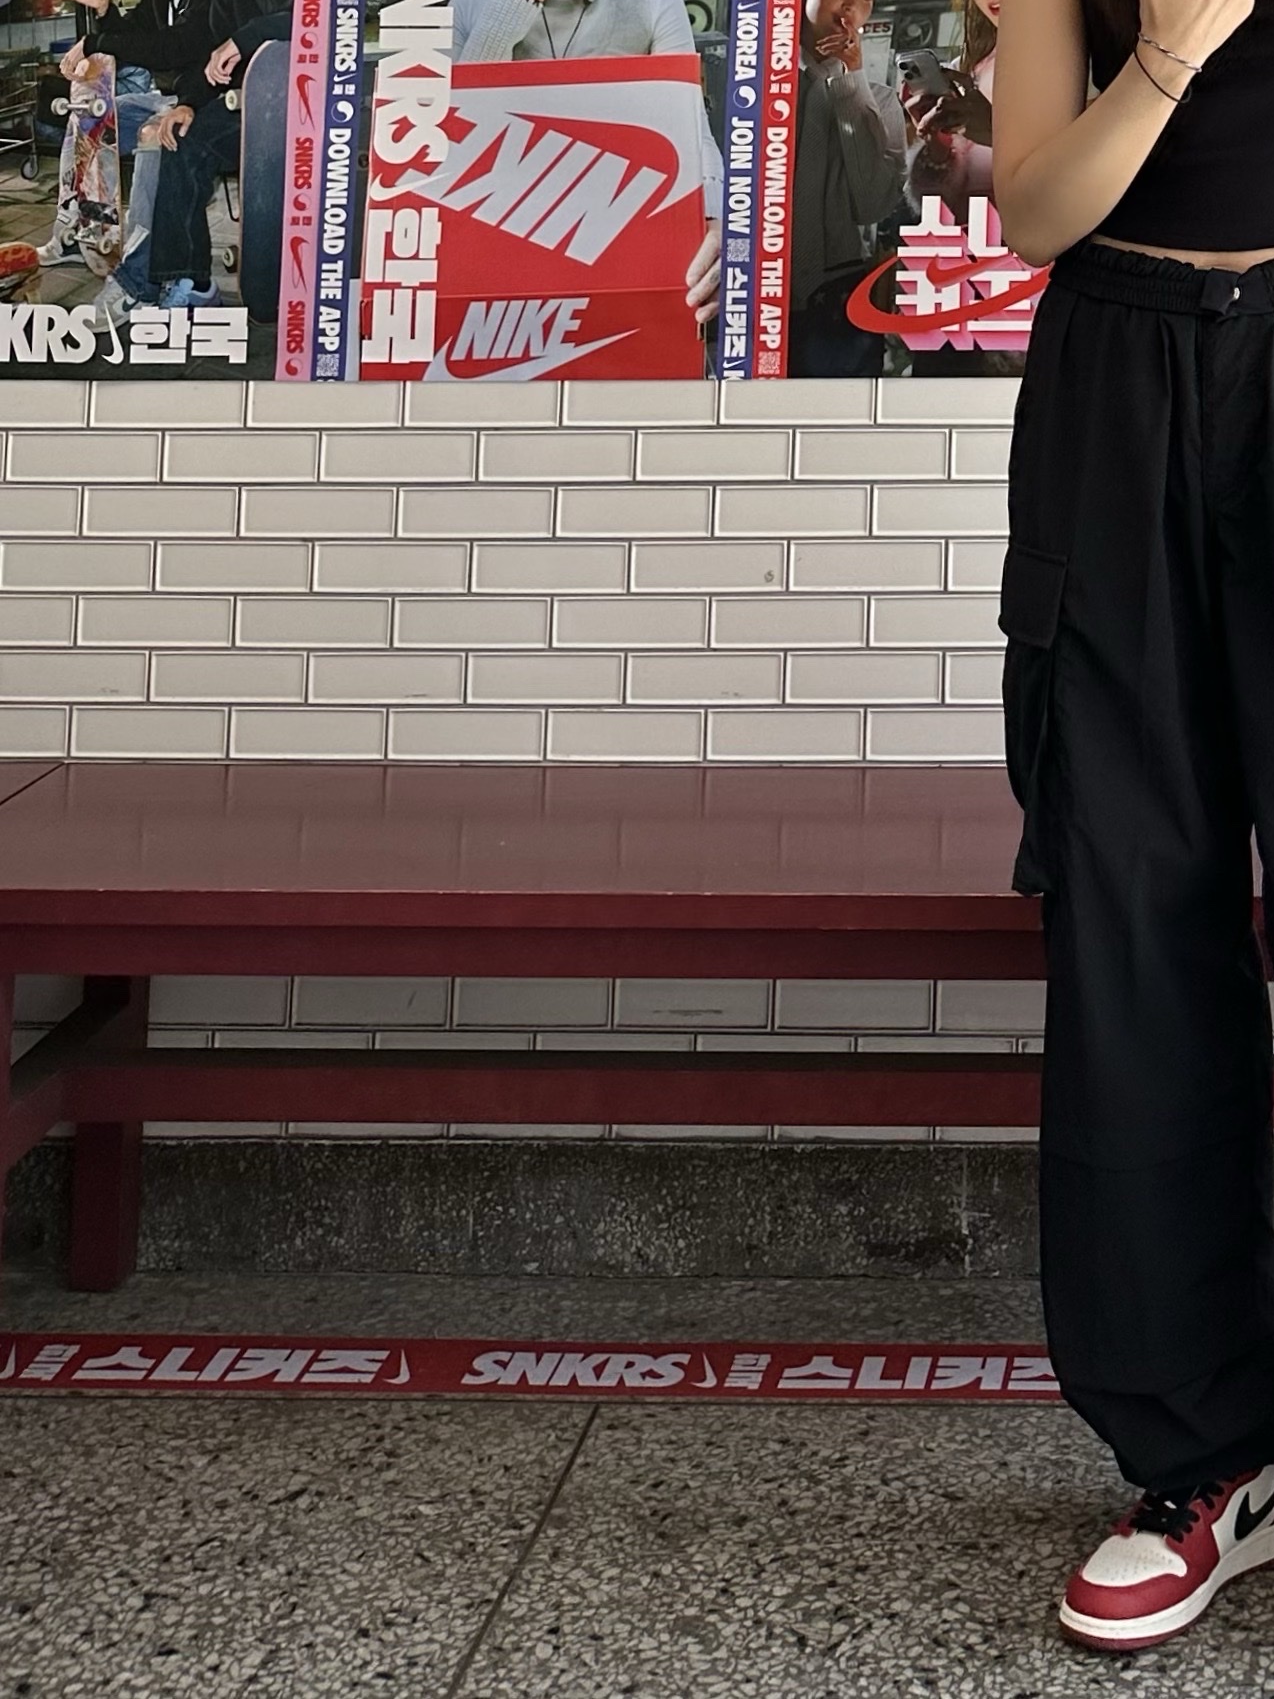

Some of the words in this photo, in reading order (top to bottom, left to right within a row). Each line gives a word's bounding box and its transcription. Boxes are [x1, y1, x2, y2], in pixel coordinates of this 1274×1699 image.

[735, 13, 758, 80] KOREA
[730, 117, 753, 169] JOIN
[728, 177, 751, 233] NOW
[361, 206, 441, 364] 한국
[0, 305, 97, 364] KRS
[129, 306, 248, 364] 한국
[451, 297, 590, 361] NIKE
[71, 1346, 391, 1383] 스니커즈
[461, 1351, 692, 1387] SNKRS
